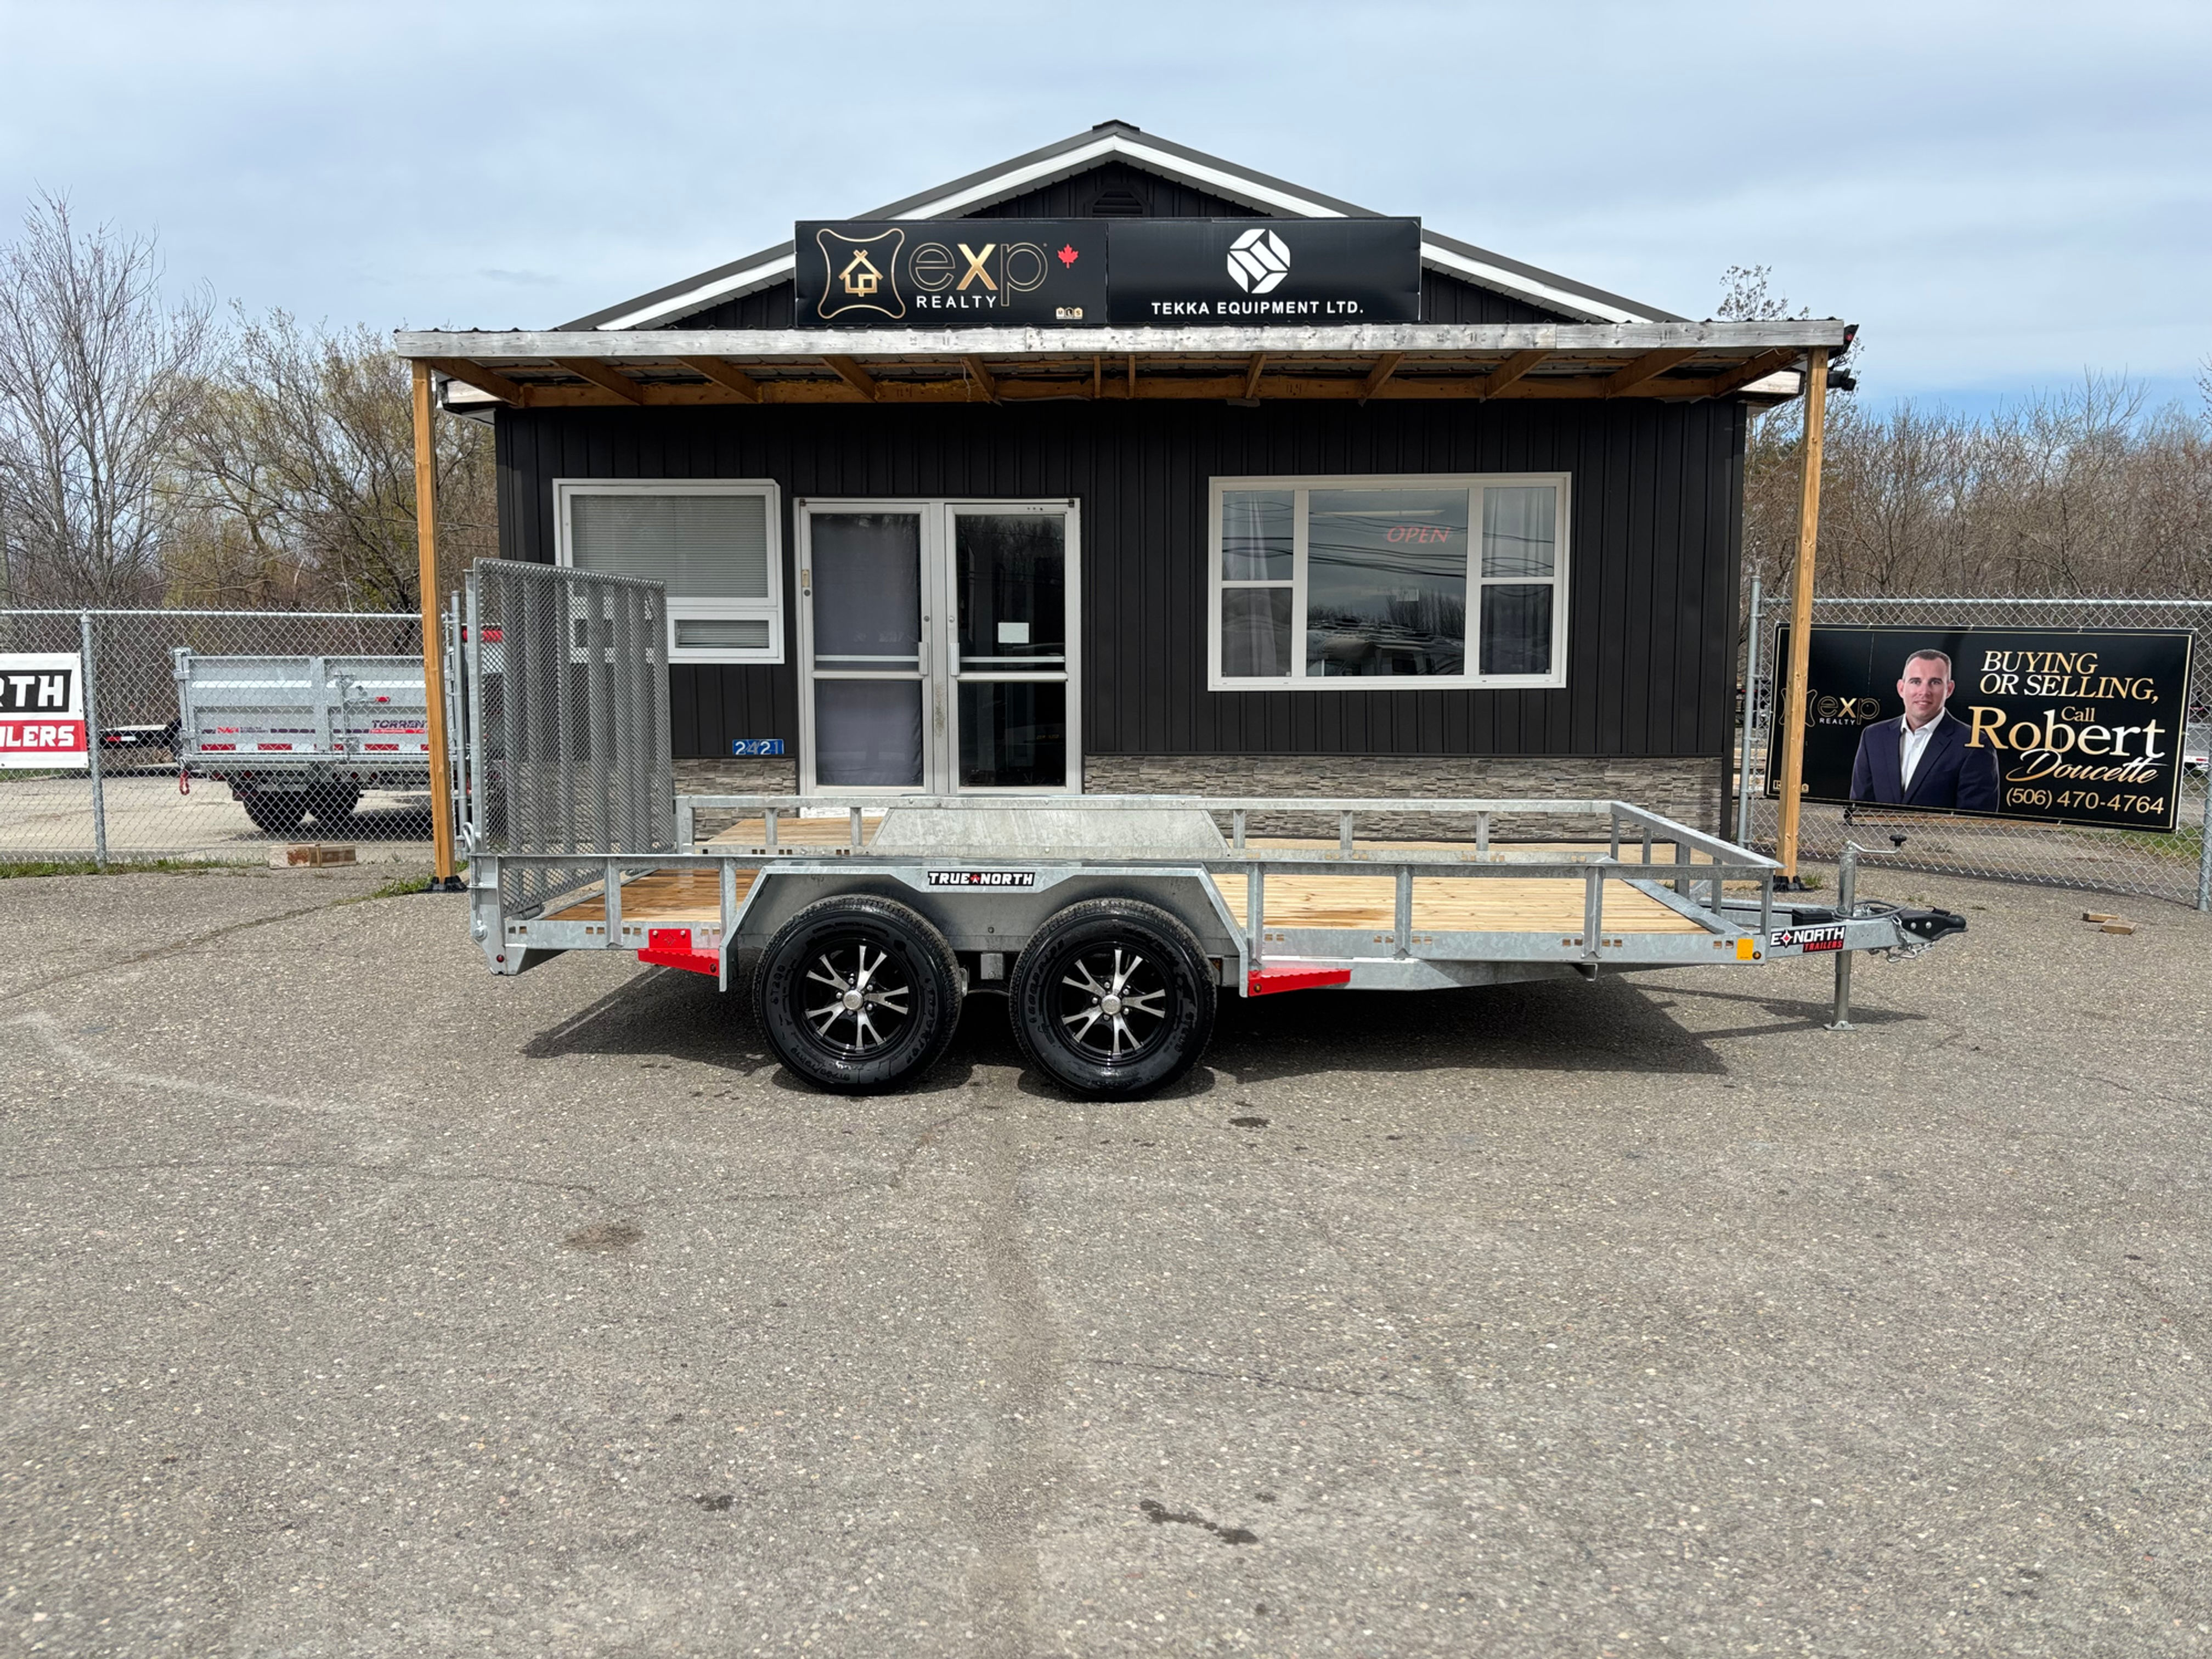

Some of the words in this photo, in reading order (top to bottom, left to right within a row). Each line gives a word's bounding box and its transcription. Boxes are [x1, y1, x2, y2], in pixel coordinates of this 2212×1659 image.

[916, 295, 997, 309] REALTY
[1151, 302, 1210, 315] TEKKA
[1217, 301, 1319, 315] EQUIPMENT
[1326, 301, 1364, 314] LTD.
[1387, 525, 1451, 544] OPEN
[1980, 650, 2098, 675] BUYING
[0, 675, 64, 707] TH
[1979, 673, 2019, 696] OR
[2023, 674, 2159, 704] SELLING,
[1819, 717, 1856, 725] REALTY
[2061, 706, 2096, 723] Call
[371, 720, 428, 729] TORREN
[1964, 706, 2166, 759] Robert
[735, 741, 779, 755] 2421
[2005, 748, 2170, 784] Doucette
[2006, 787, 2053, 809] (506)
[2056, 790, 2164, 814] 470-4764
[929, 872, 970, 884] TRUE
[980, 873, 1033, 885] NORTH
[1792, 926, 1846, 944] NORTH
[1804, 940, 1843, 951] TRAILERS
